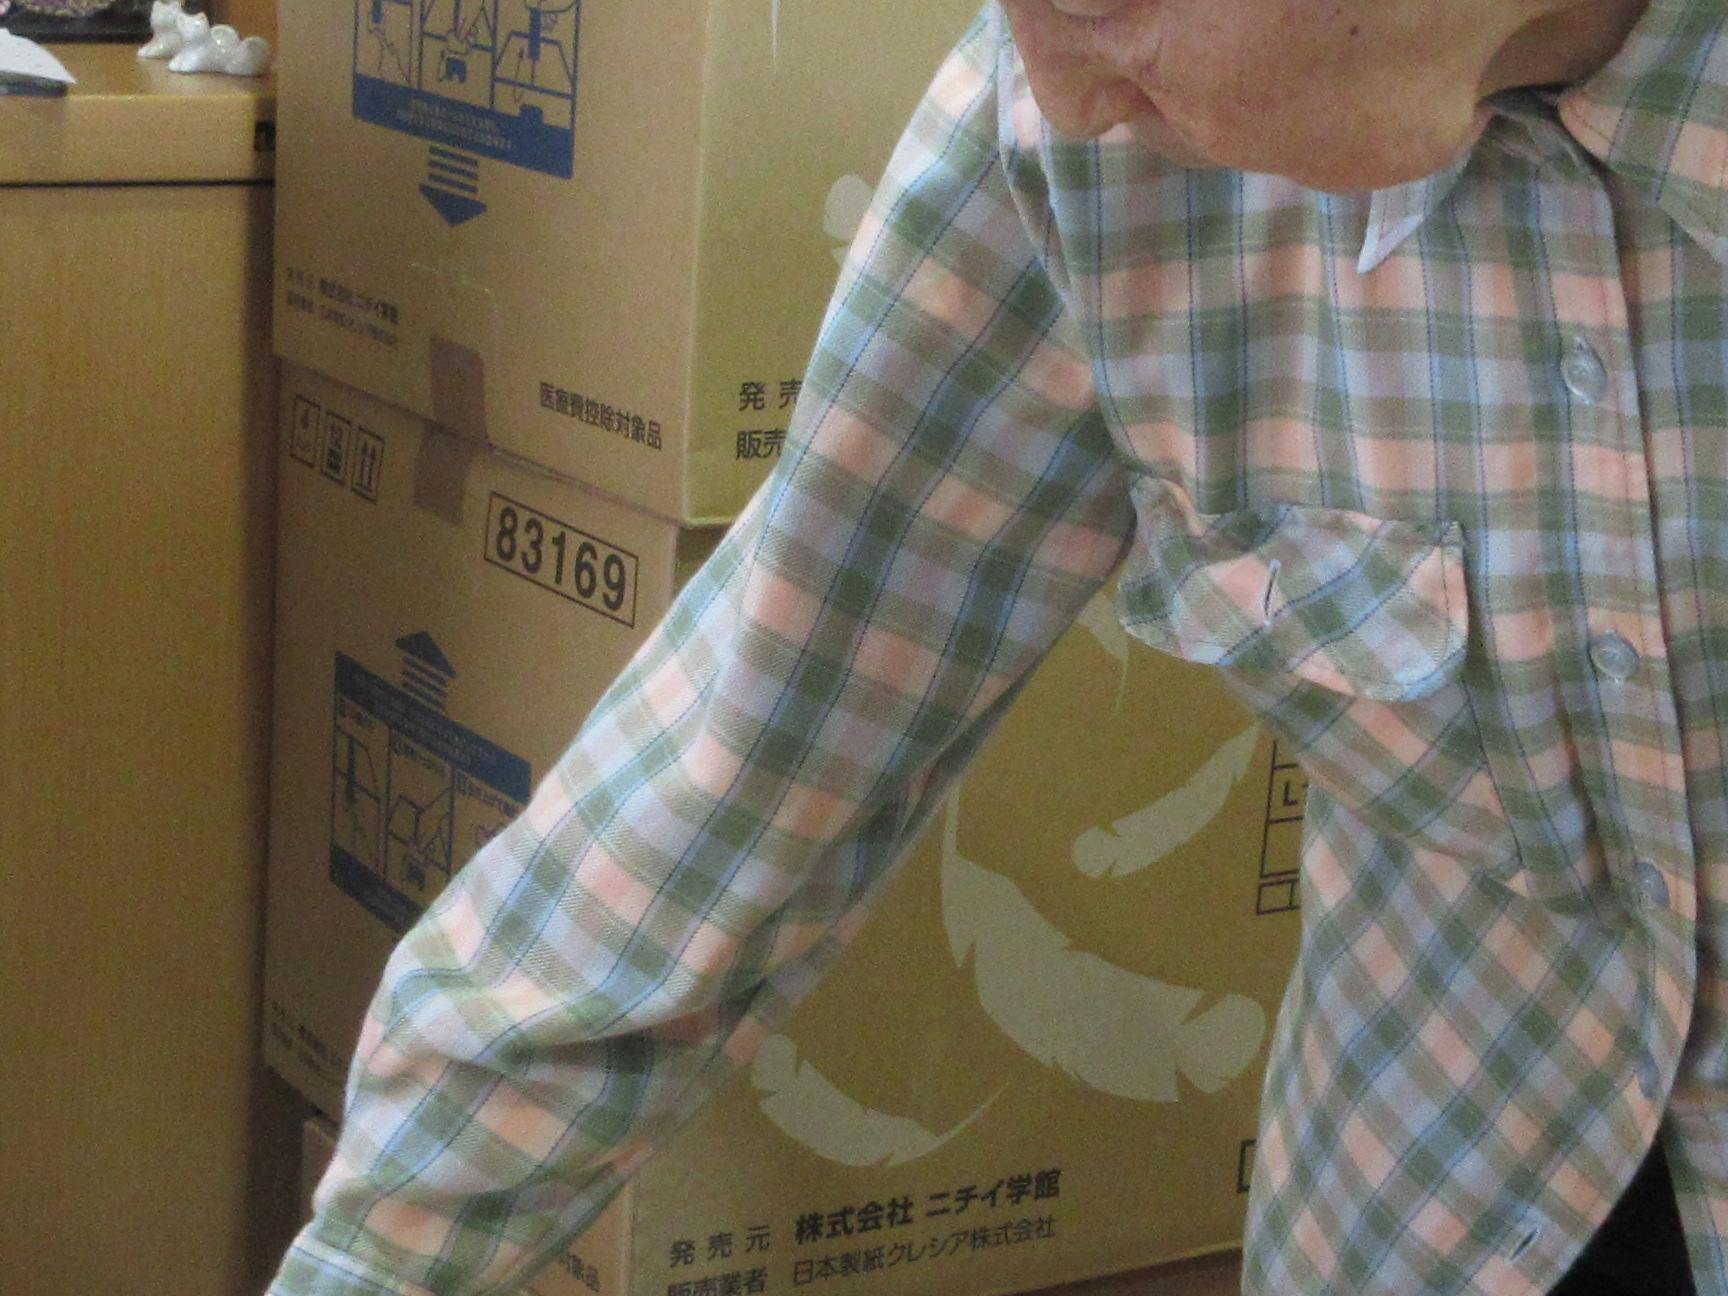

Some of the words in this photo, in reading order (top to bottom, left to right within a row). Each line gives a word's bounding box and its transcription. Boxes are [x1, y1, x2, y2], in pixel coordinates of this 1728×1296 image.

[496, 507, 625, 611] 83169
[795, 1197, 913, 1245] 株式会社
[925, 1168, 1062, 1218] ニチイ学館
[793, 1214, 1057, 1287] 日本製紙クレシア株式会社
